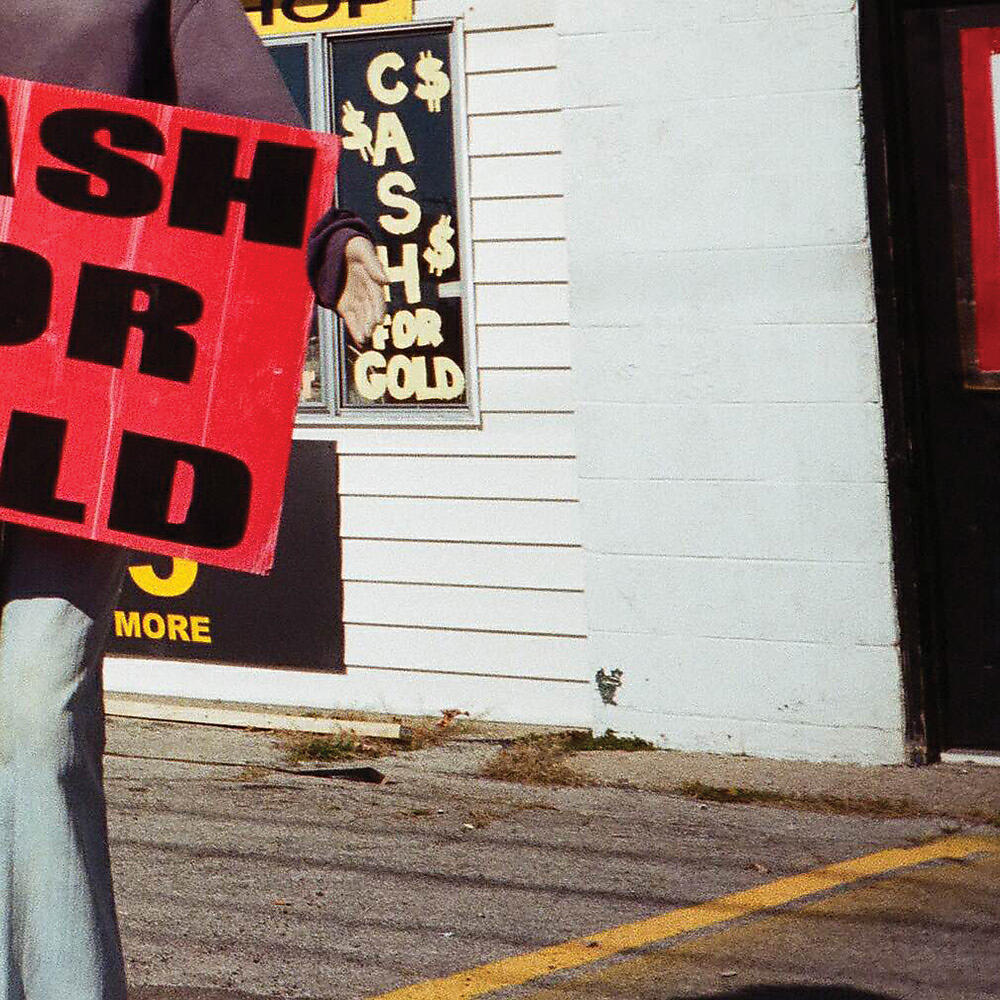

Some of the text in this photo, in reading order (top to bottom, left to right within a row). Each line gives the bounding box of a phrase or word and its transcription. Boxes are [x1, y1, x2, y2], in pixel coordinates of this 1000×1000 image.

[372, 308, 444, 350] FOR
[355, 350, 465, 401] GOLD
[114, 610, 212, 643] MORE
